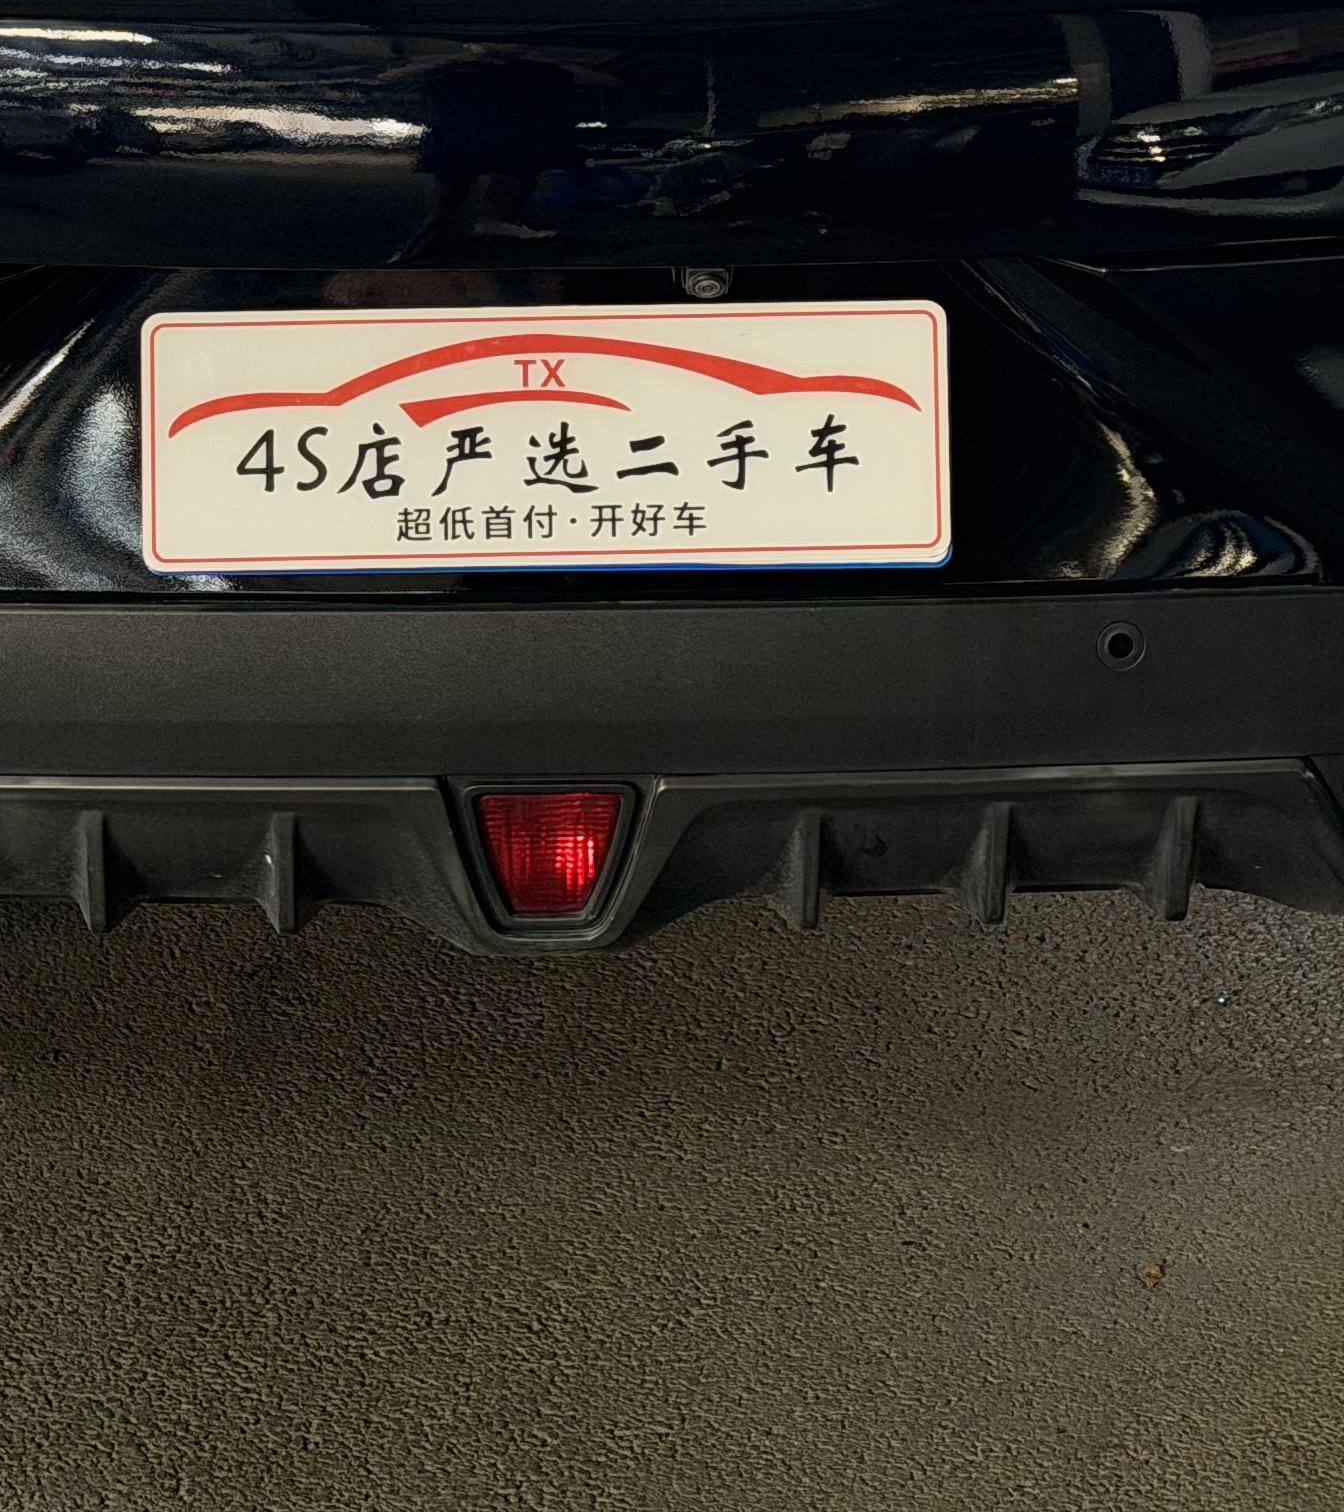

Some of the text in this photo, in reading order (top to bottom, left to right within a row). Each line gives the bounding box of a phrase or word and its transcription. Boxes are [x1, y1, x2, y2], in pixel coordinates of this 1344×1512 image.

[513, 359, 567, 388] TX
[236, 413, 861, 500] 4S店严选二手车
[396, 501, 708, 542] 超低首付·开好车
